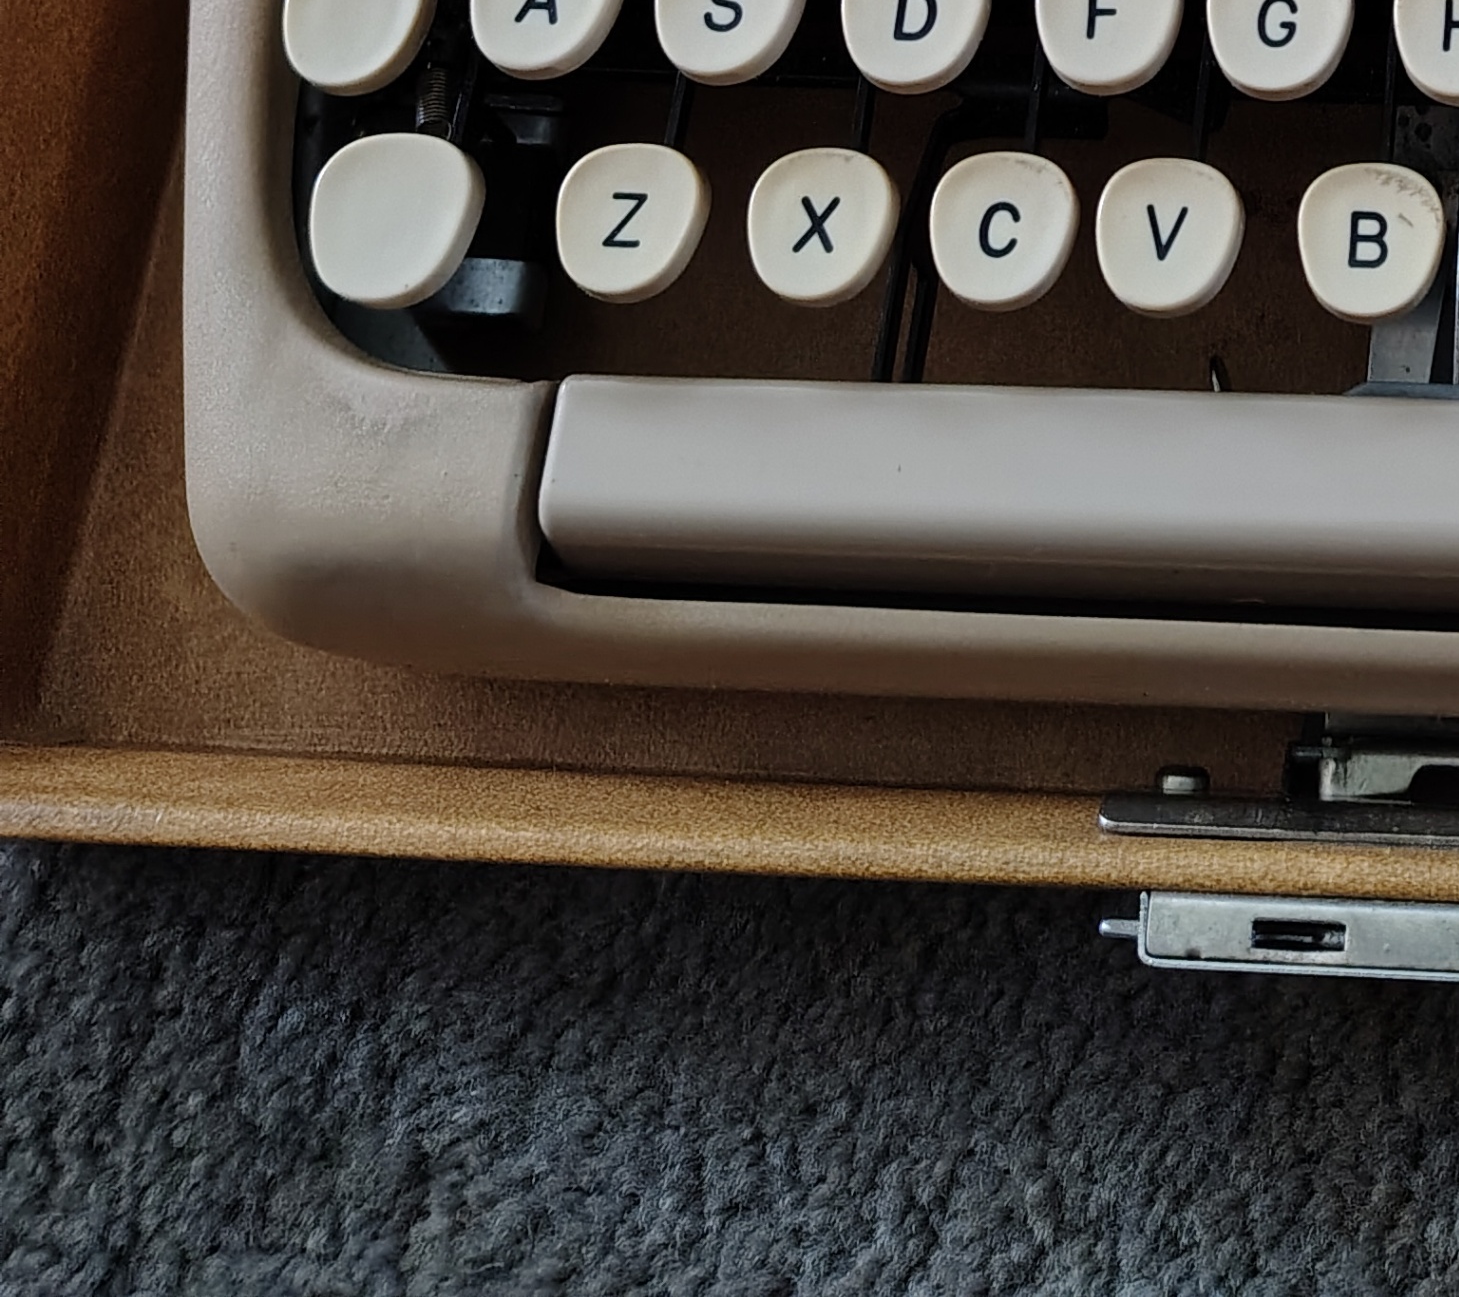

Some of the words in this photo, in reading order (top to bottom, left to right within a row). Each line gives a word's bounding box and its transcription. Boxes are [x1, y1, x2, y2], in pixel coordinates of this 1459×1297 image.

[600, 191, 649, 249] Z
[791, 194, 842, 255] X
[977, 200, 1022, 260] C
[1145, 203, 1190, 262] V
[1346, 209, 1389, 270] B
